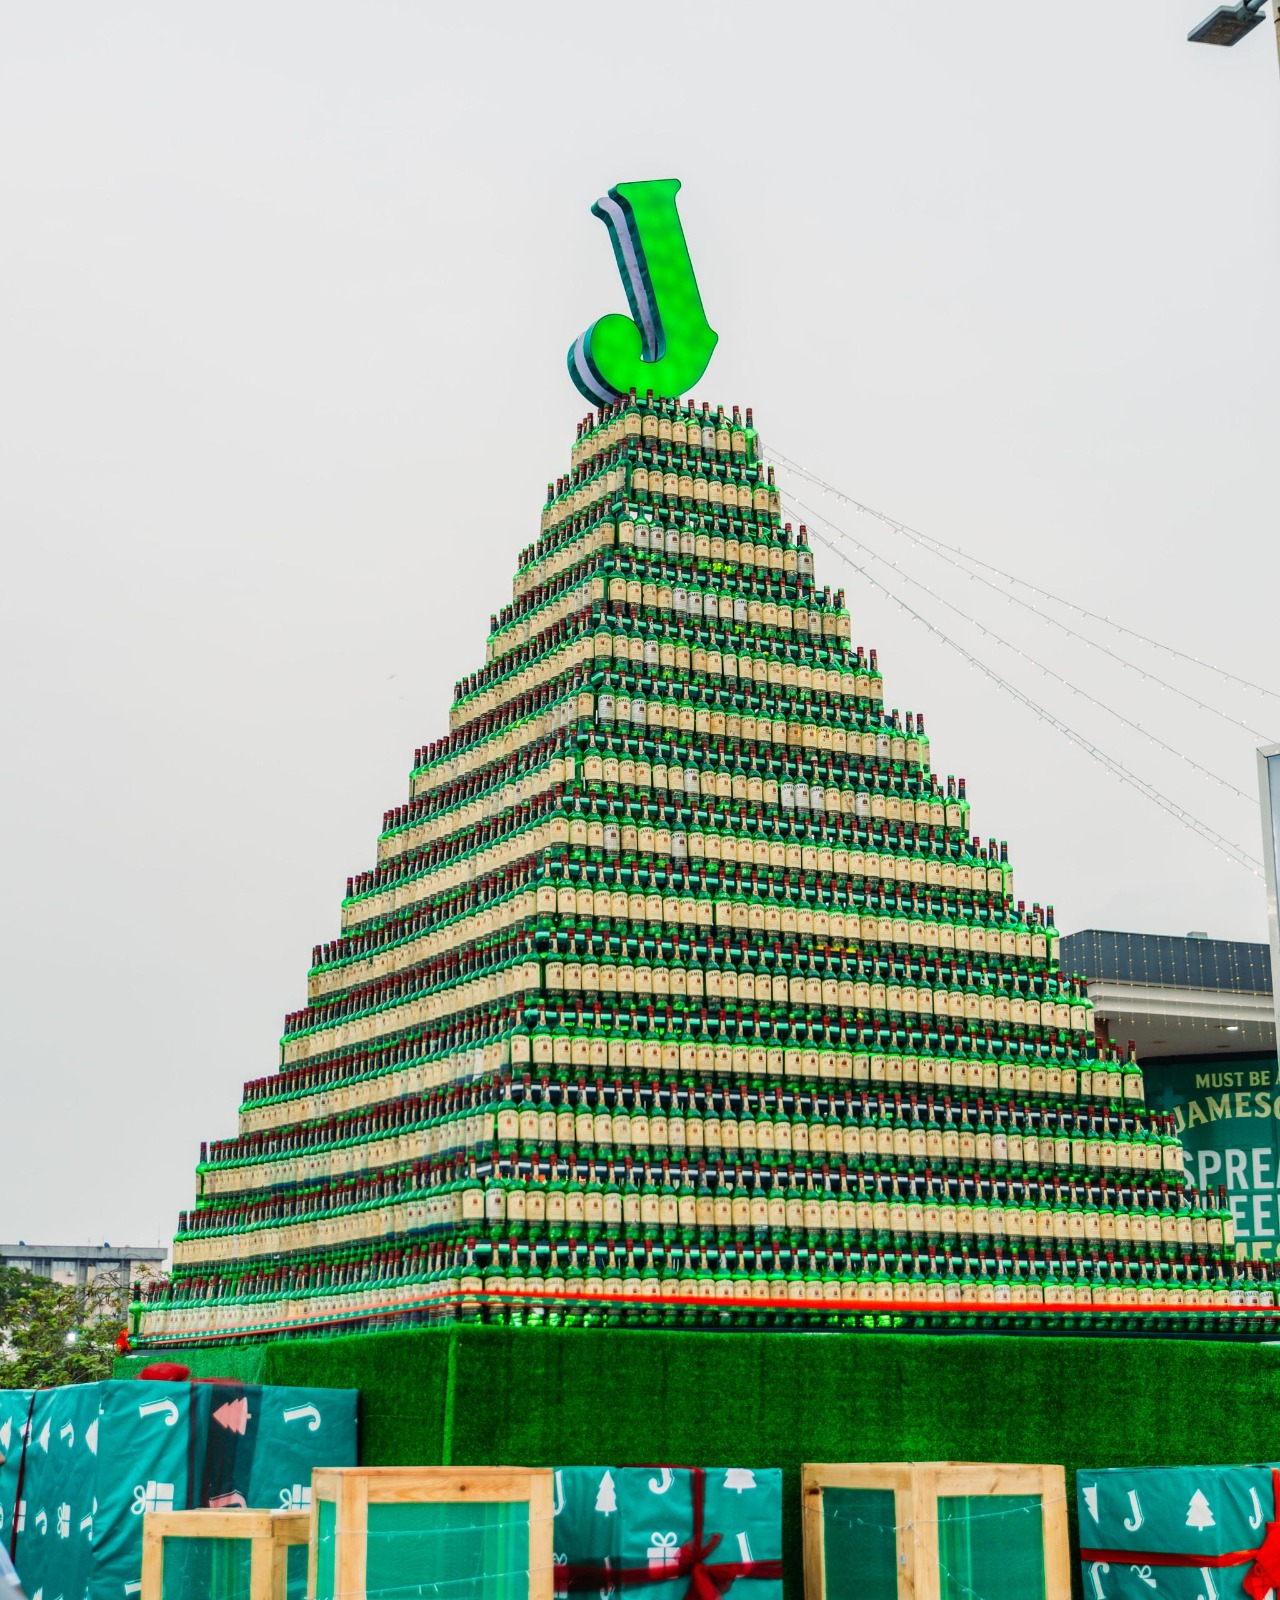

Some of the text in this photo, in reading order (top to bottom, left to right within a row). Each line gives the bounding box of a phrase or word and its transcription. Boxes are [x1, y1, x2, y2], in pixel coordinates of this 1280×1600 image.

[567, 178, 719, 407] J
[1195, 1072, 1244, 1089] MUST
[1249, 1071, 1271, 1087] BE
[1183, 1147, 1280, 1191] SPRE
